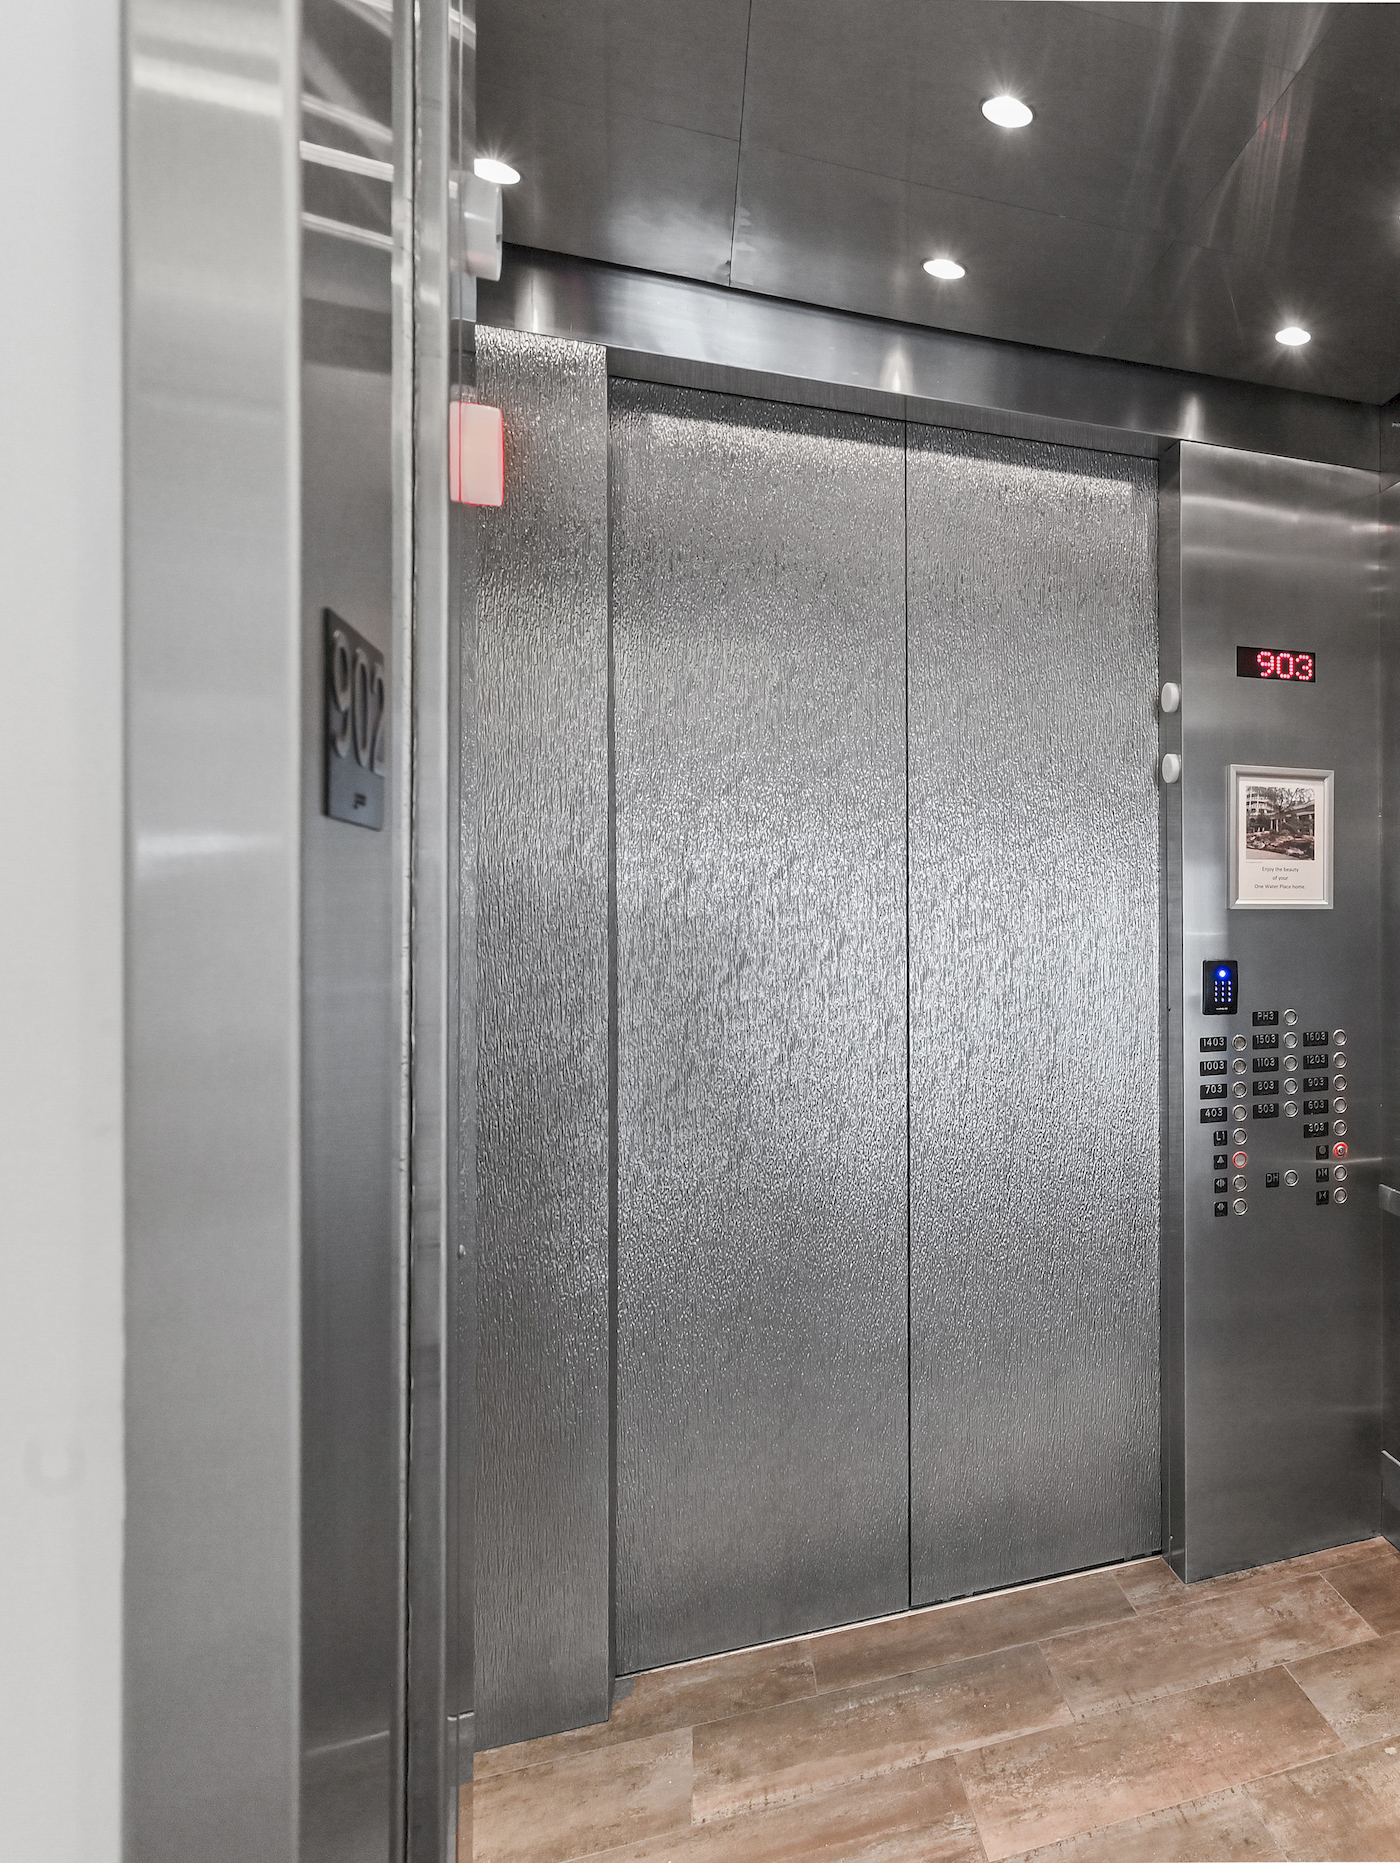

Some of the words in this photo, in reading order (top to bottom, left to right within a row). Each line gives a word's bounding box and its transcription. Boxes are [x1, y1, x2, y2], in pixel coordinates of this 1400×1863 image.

[1257, 651, 1313, 680] 903
[1258, 1012, 1274, 1020] PH3
[1256, 1034, 1276, 1044] 1503
[1306, 1032, 1326, 1041] 1603
[1203, 1038, 1225, 1047] 1403
[1257, 1058, 1275, 1067] 1103
[1306, 1055, 1326, 1064] 1203
[1203, 1061, 1225, 1070] 1003
[1308, 1078, 1324, 1087] 903
[1205, 1084, 1223, 1094] 703
[1258, 1104, 1274, 1113] 503
[1308, 1100, 1324, 1109] 603
[1205, 1108, 1223, 1117] 403
[1308, 1123, 1324, 1132] 303
[1216, 1131, 1226, 1141] L1
[1267, 1174, 1279, 1183] DH
